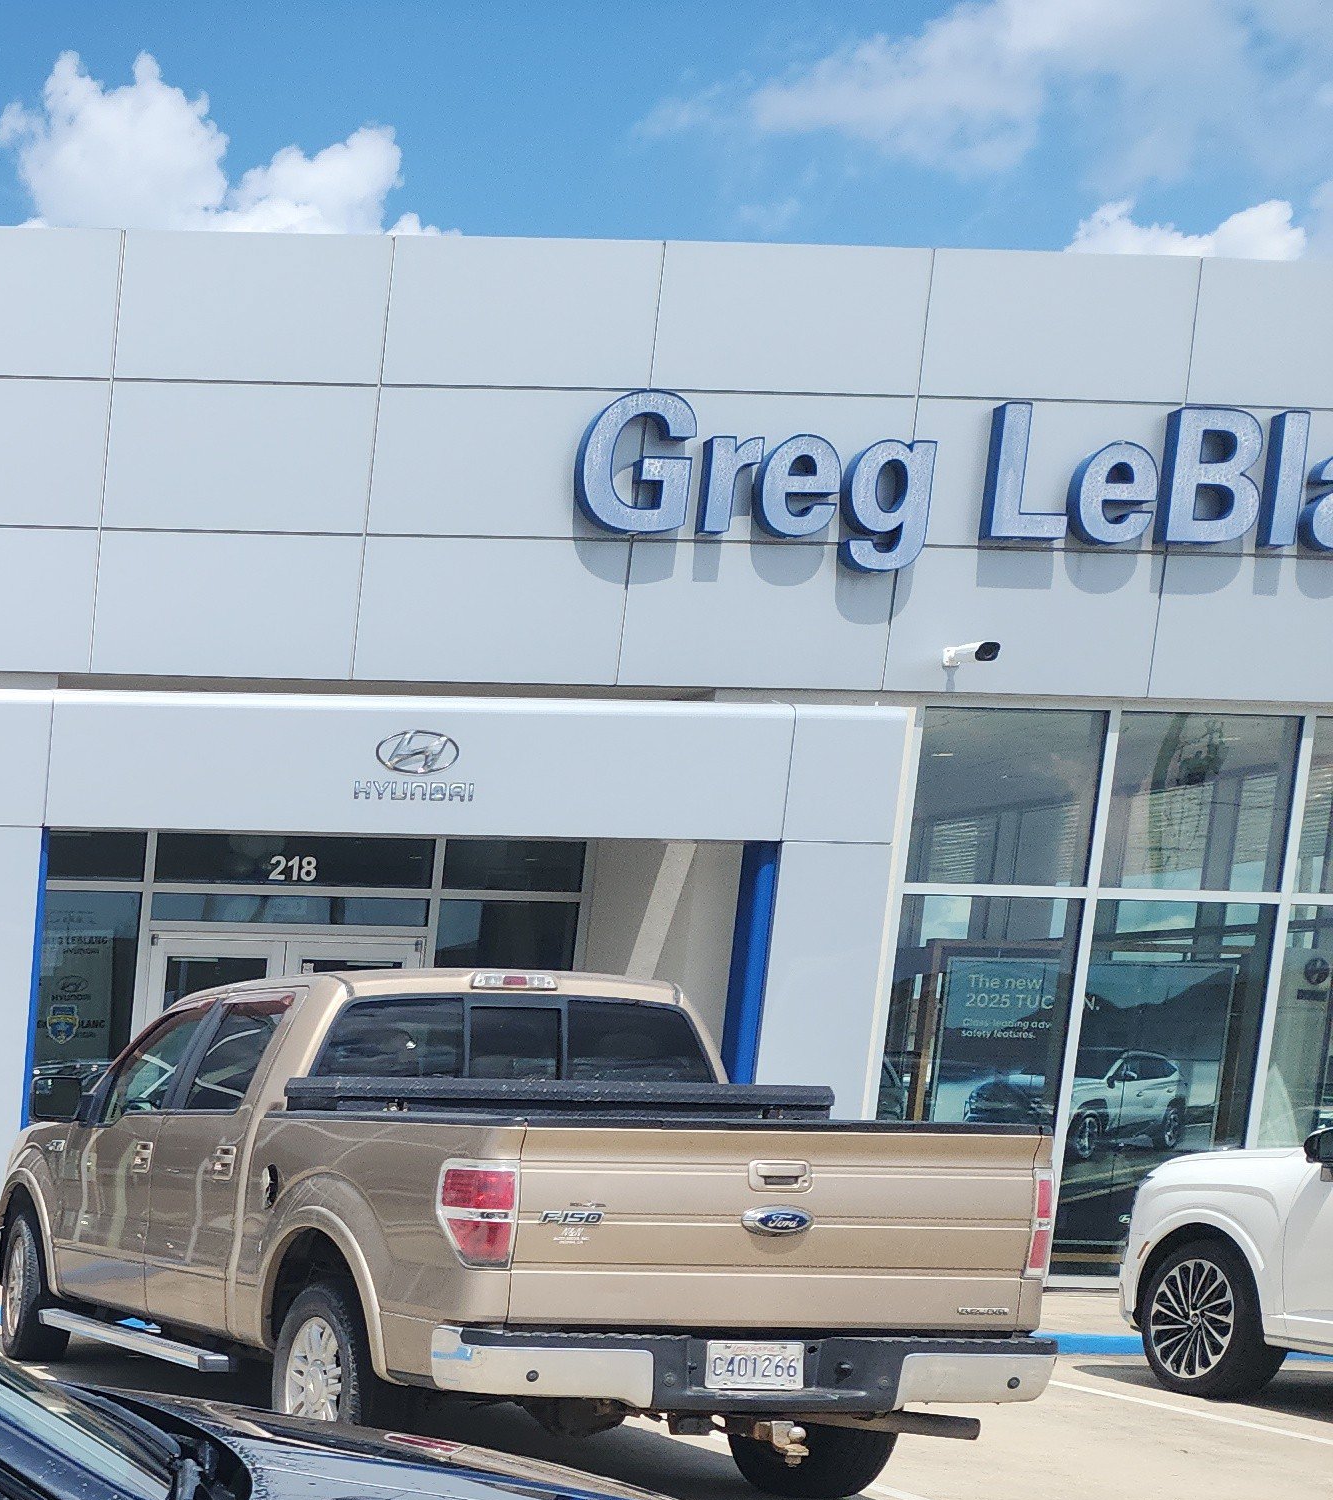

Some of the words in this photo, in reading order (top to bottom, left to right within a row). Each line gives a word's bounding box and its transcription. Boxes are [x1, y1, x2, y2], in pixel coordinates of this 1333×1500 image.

[574, 389, 937, 573] Greg
[353, 780, 475, 802] HYUNDAI
[268, 855, 317, 882] 218
[968, 974, 1000, 989] The
[1005, 979, 1043, 990] new
[965, 993, 1010, 1008] 2025
[1014, 995, 1100, 1011] TUCN.
[539, 1210, 604, 1225] F-150
[767, 1214, 800, 1228] Ford
[713, 1356, 797, 1378] C401266
